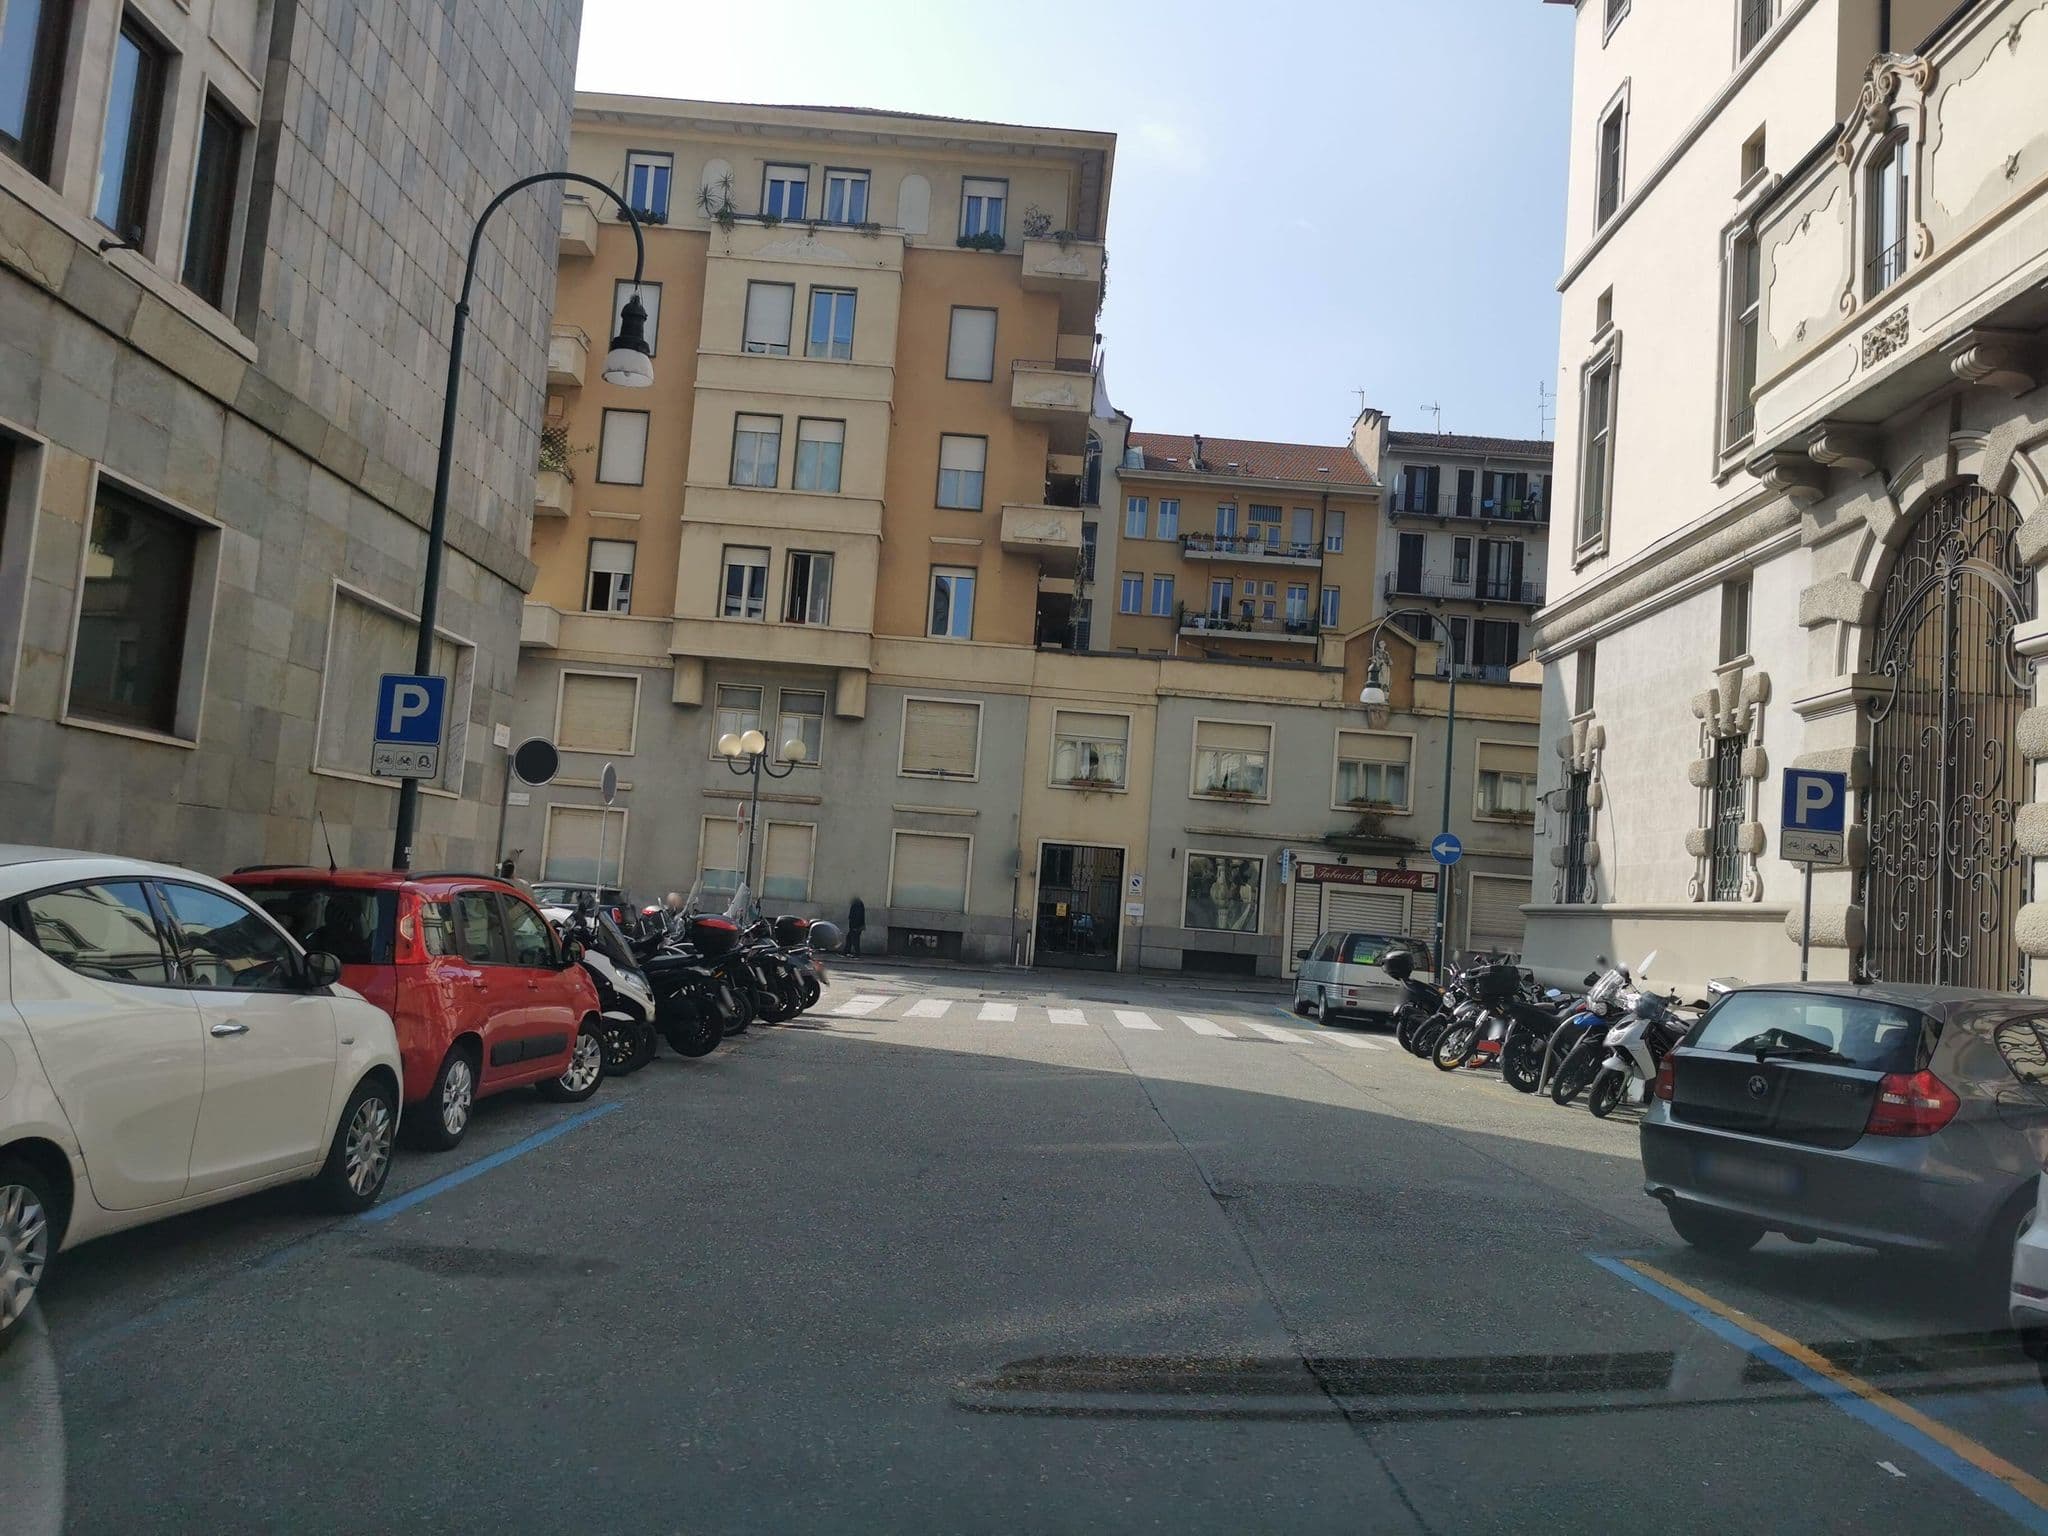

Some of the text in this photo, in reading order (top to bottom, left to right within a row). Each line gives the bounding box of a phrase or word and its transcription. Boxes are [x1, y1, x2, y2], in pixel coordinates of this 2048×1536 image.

[390, 684, 430, 733] P
[1795, 776, 1834, 824] P
[1380, 871, 1419, 885] Edicola
